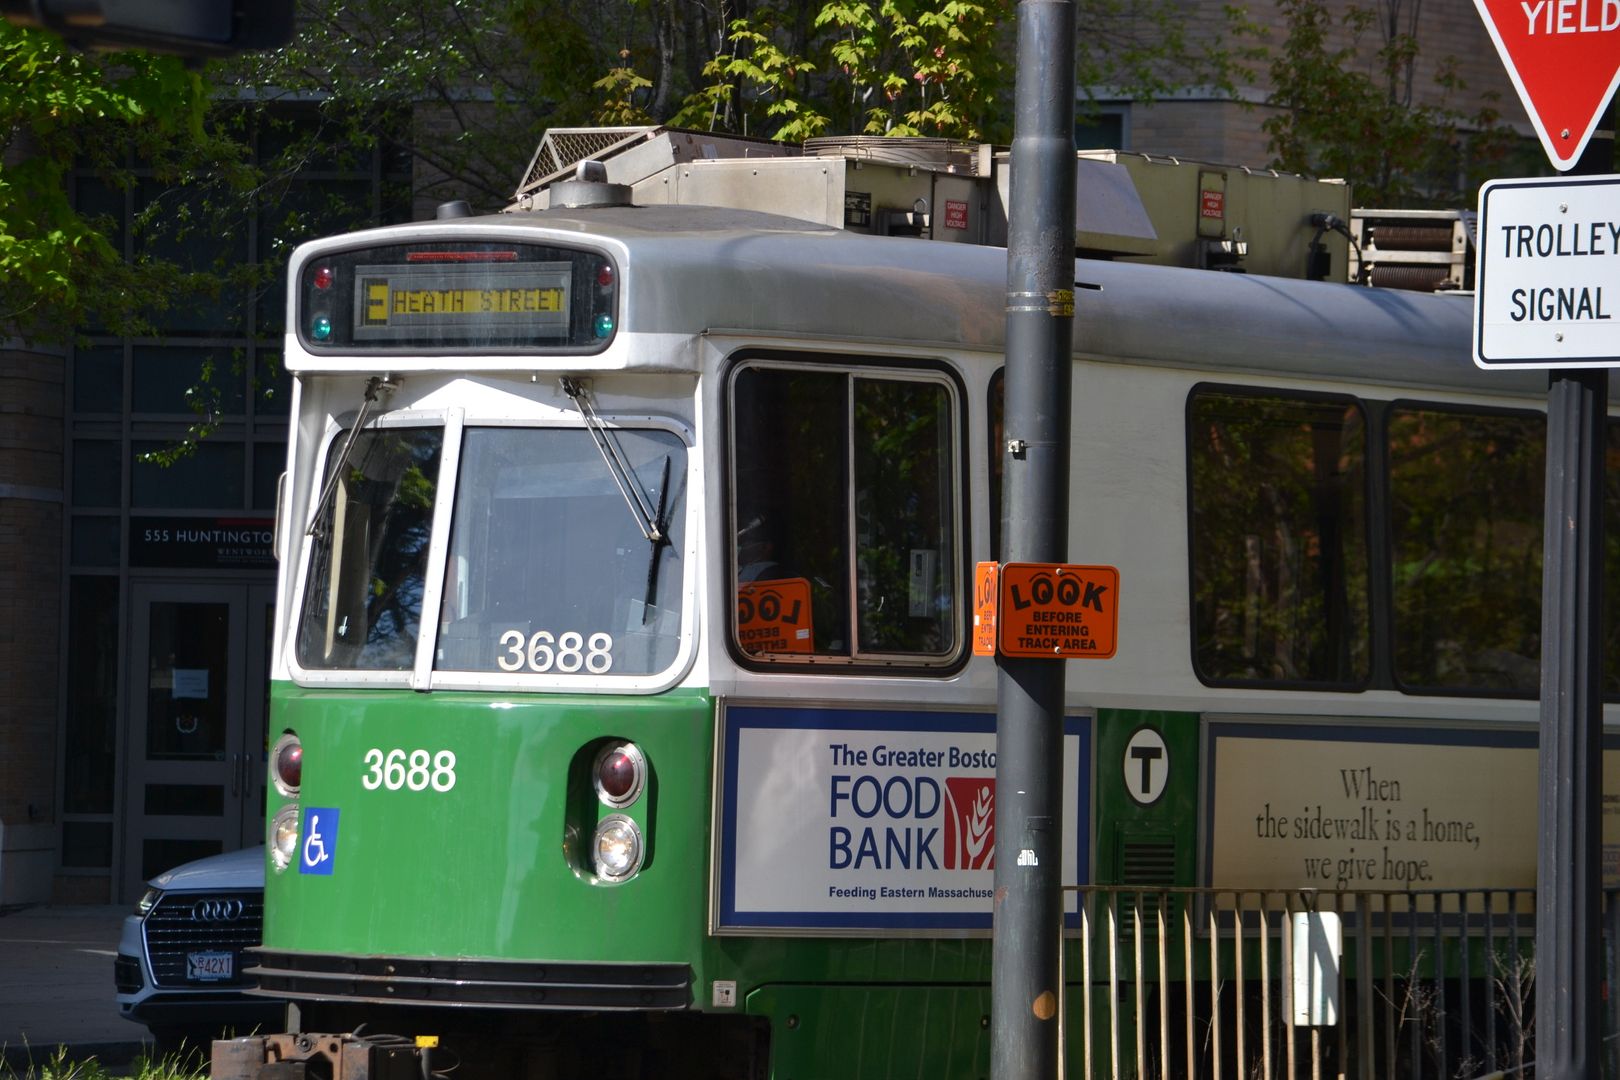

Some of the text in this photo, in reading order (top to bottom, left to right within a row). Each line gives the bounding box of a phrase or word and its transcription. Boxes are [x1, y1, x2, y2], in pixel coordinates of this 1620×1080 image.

[1521, 0, 1620, 35] YIELD
[1501, 222, 1620, 258] TROLLEY
[393, 290, 465, 313] HEATH
[480, 287, 564, 312] STREET
[1510, 287, 1611, 322] SIGNAL
[144, 529, 169, 542] 555
[1010, 577, 1108, 613] LOOK
[1026, 624, 1089, 636] ENTERING
[1033, 611, 1082, 623] BEFORE
[498, 630, 613, 674] 3688
[1017, 637, 1097, 650] TRACK AREA
[362, 748, 457, 792] 3688
[829, 744, 997, 768] The Greater Bosto
[1131, 746, 1162, 794] T
[830, 775, 941, 819] FOOD
[1340, 766, 1401, 801] When
[1256, 803, 1480, 849] the sidewalk is a home,
[829, 826, 940, 870] BANK
[1304, 846, 1433, 890] we give hope.
[829, 886, 994, 900] Feeding Eastern Massachuse
